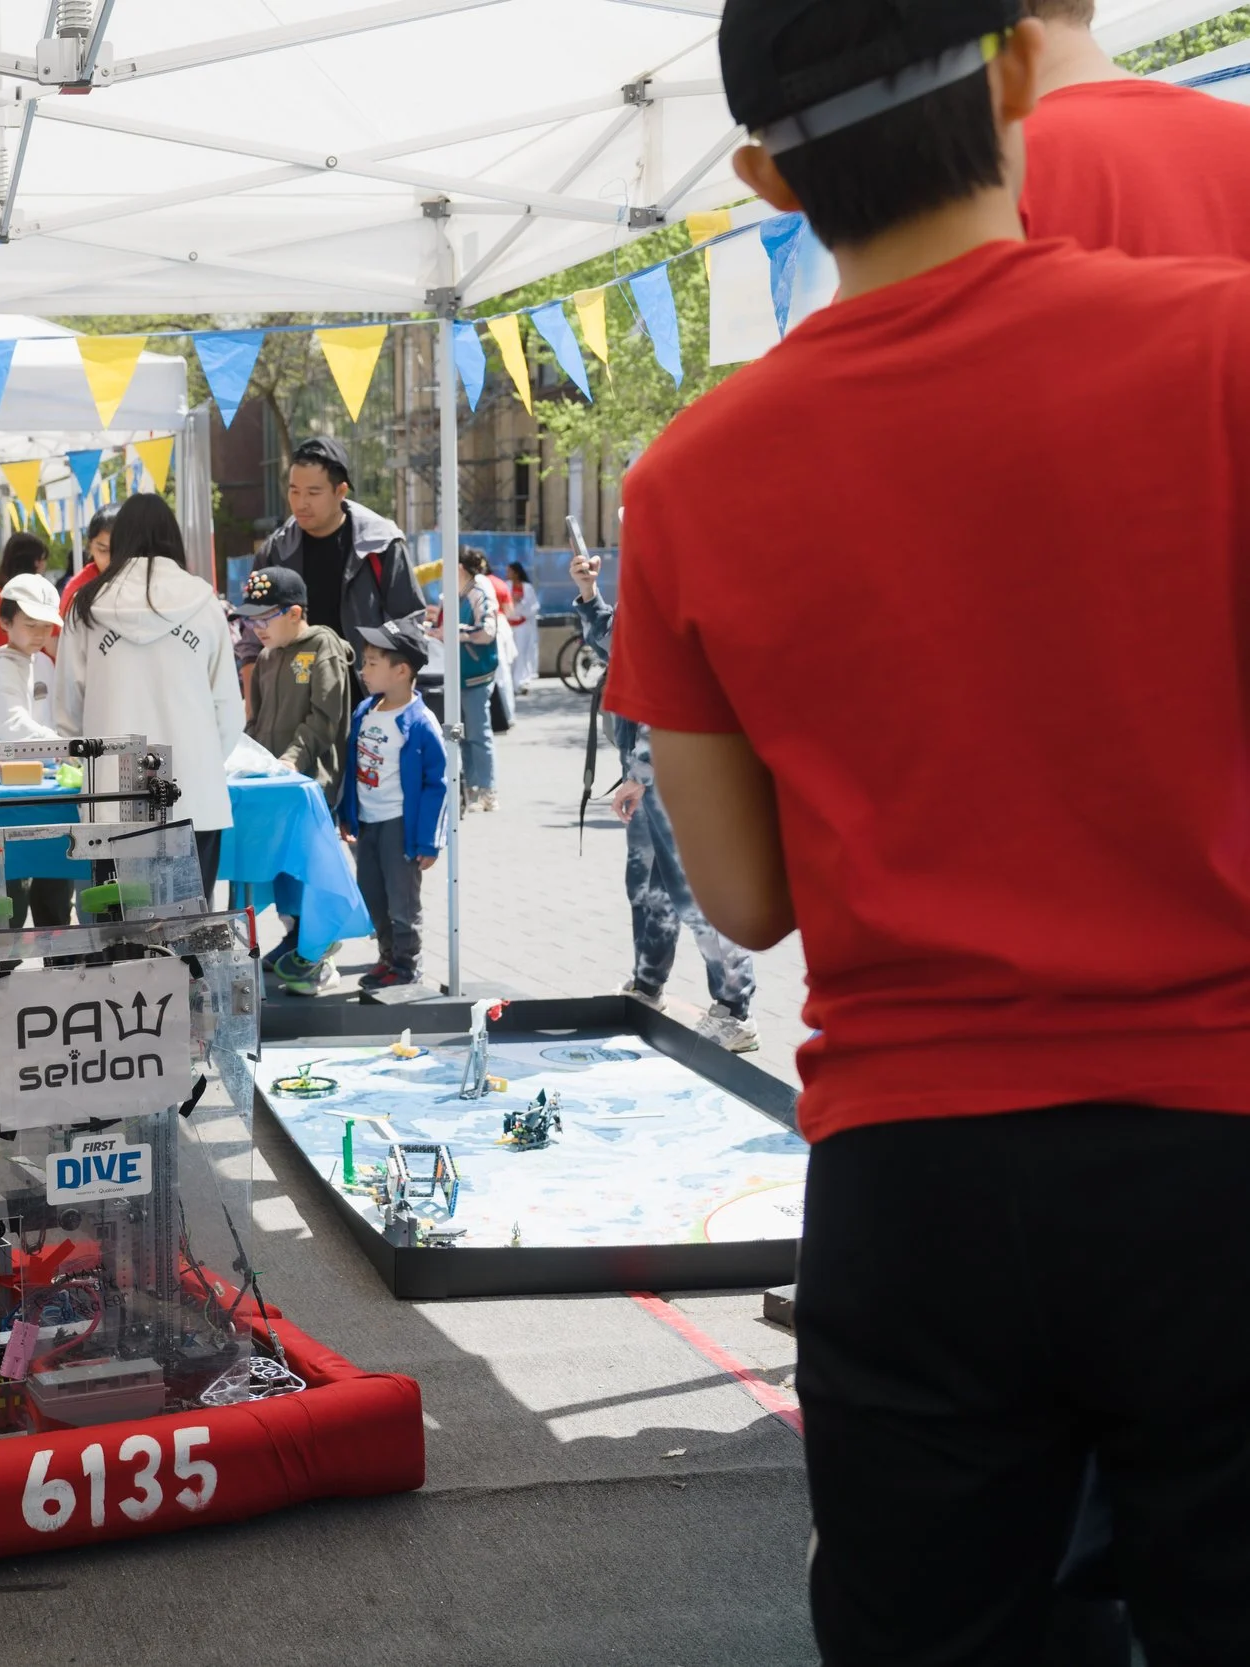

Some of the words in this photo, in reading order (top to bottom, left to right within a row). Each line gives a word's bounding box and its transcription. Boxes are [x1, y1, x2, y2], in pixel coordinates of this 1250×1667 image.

[182, 629, 200, 653] CO.
[18, 1049, 164, 1092] seidon
[82, 1140, 116, 1153] FIRST
[57, 1151, 141, 1189] DIVE
[22, 1426, 218, 1533] 6135
